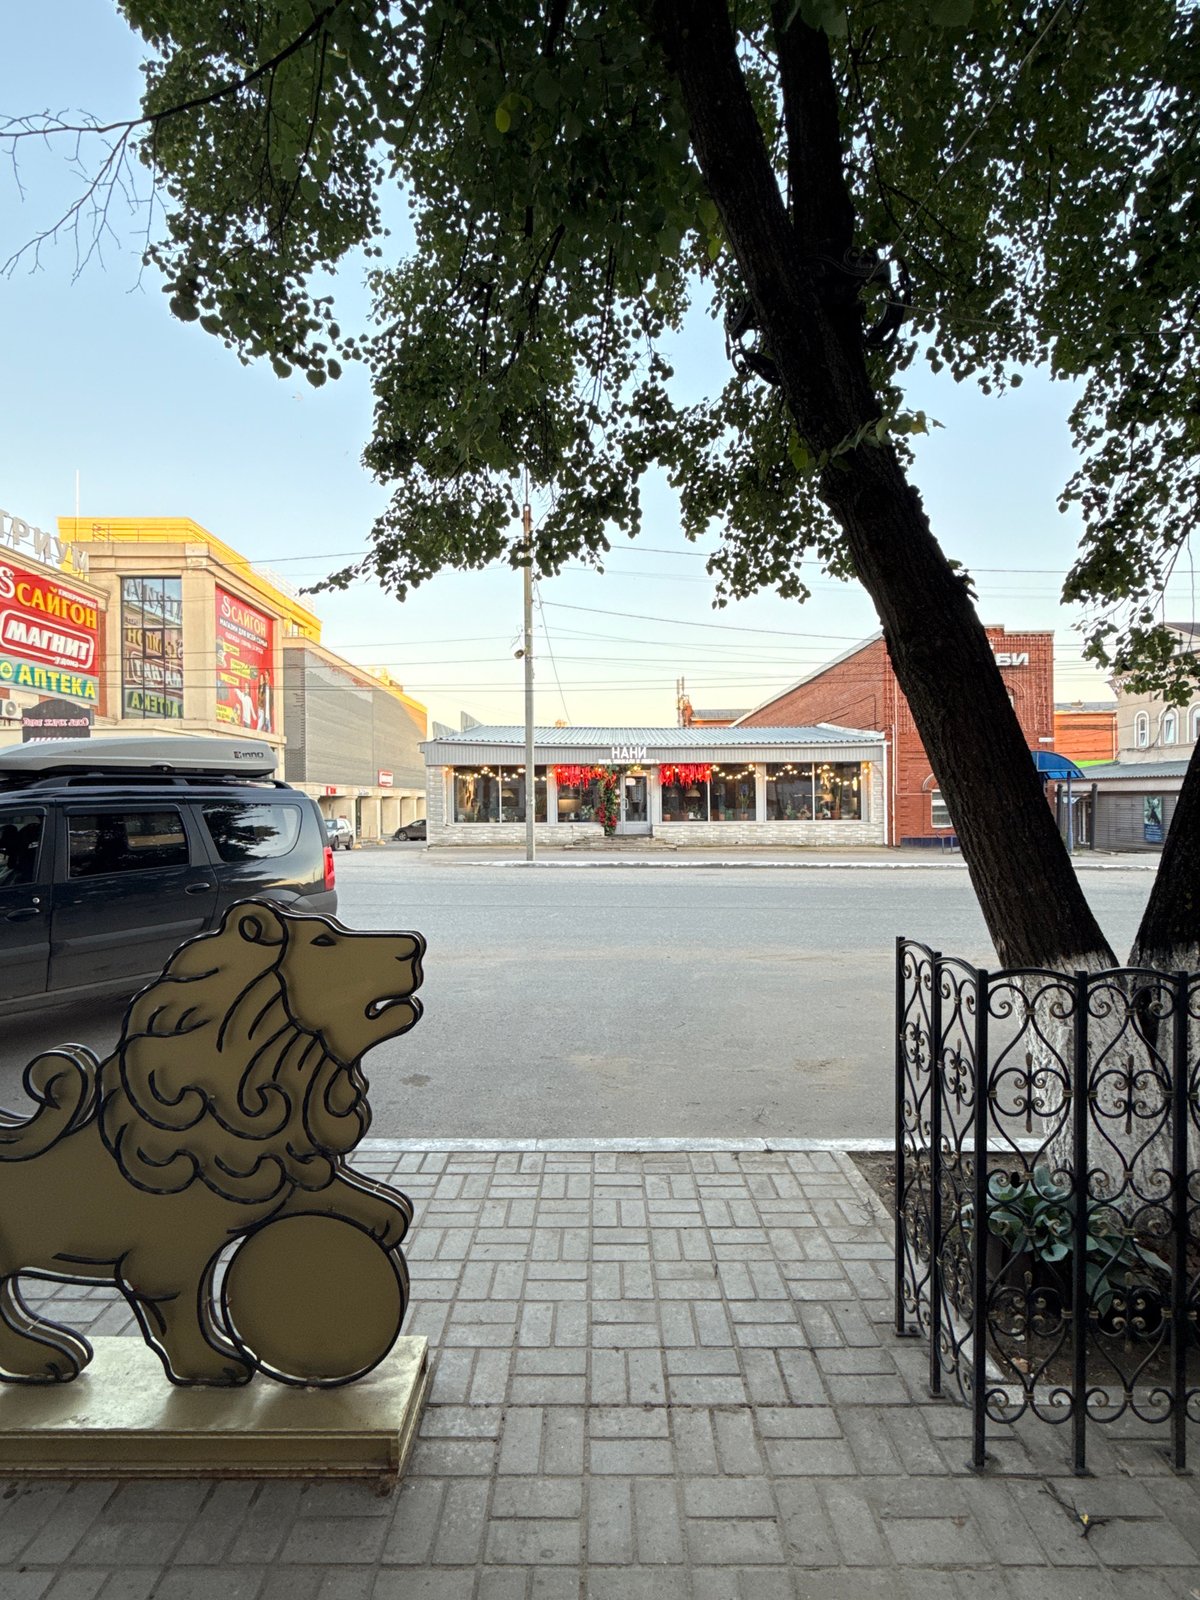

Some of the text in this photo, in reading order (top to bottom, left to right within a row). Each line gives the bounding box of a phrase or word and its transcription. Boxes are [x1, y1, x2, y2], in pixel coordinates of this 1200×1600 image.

[4, 620, 89, 660] МАГНИТ
[17, 663, 96, 699] АПТЕКА
[611, 746, 647, 759] НАНИ
